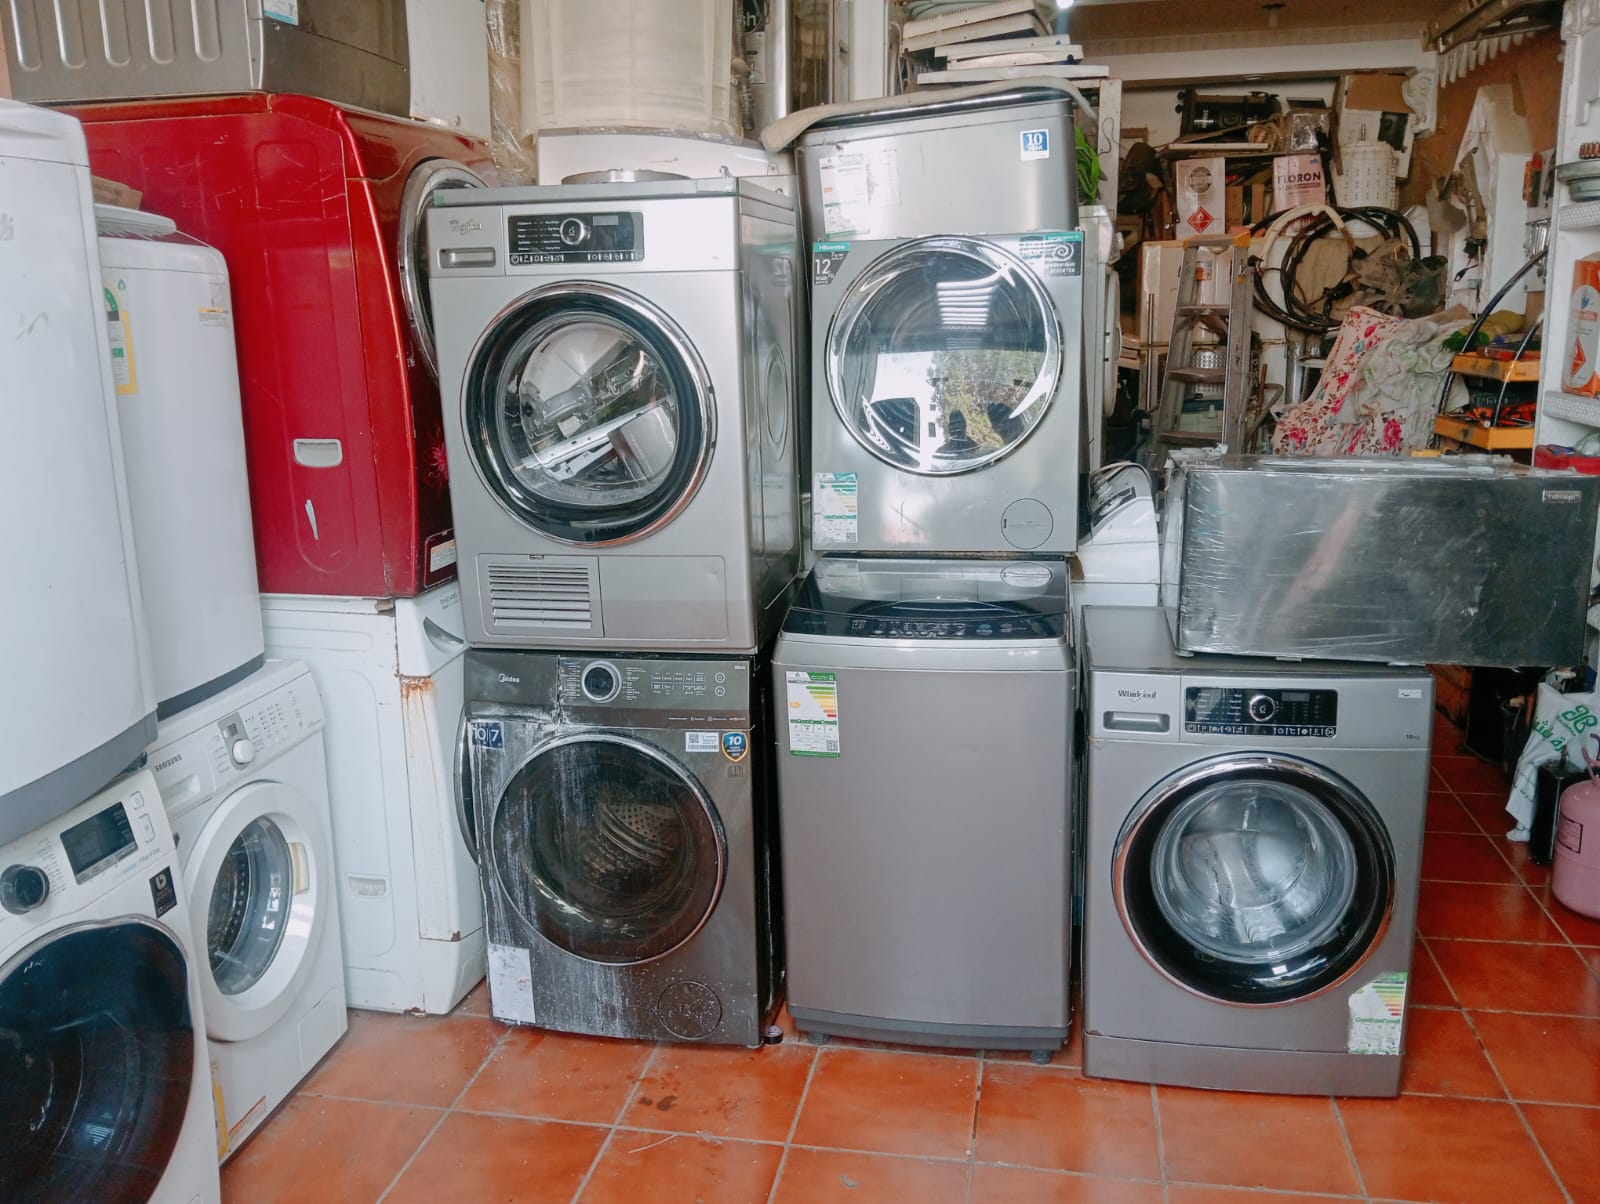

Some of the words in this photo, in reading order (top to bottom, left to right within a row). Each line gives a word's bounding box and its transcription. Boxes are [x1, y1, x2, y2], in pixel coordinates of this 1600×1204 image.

[1026, 133, 1043, 146] 10
[815, 259, 831, 275] 12
[729, 735, 742, 746] 10
[154, 753, 183, 772] SAMSUNG
